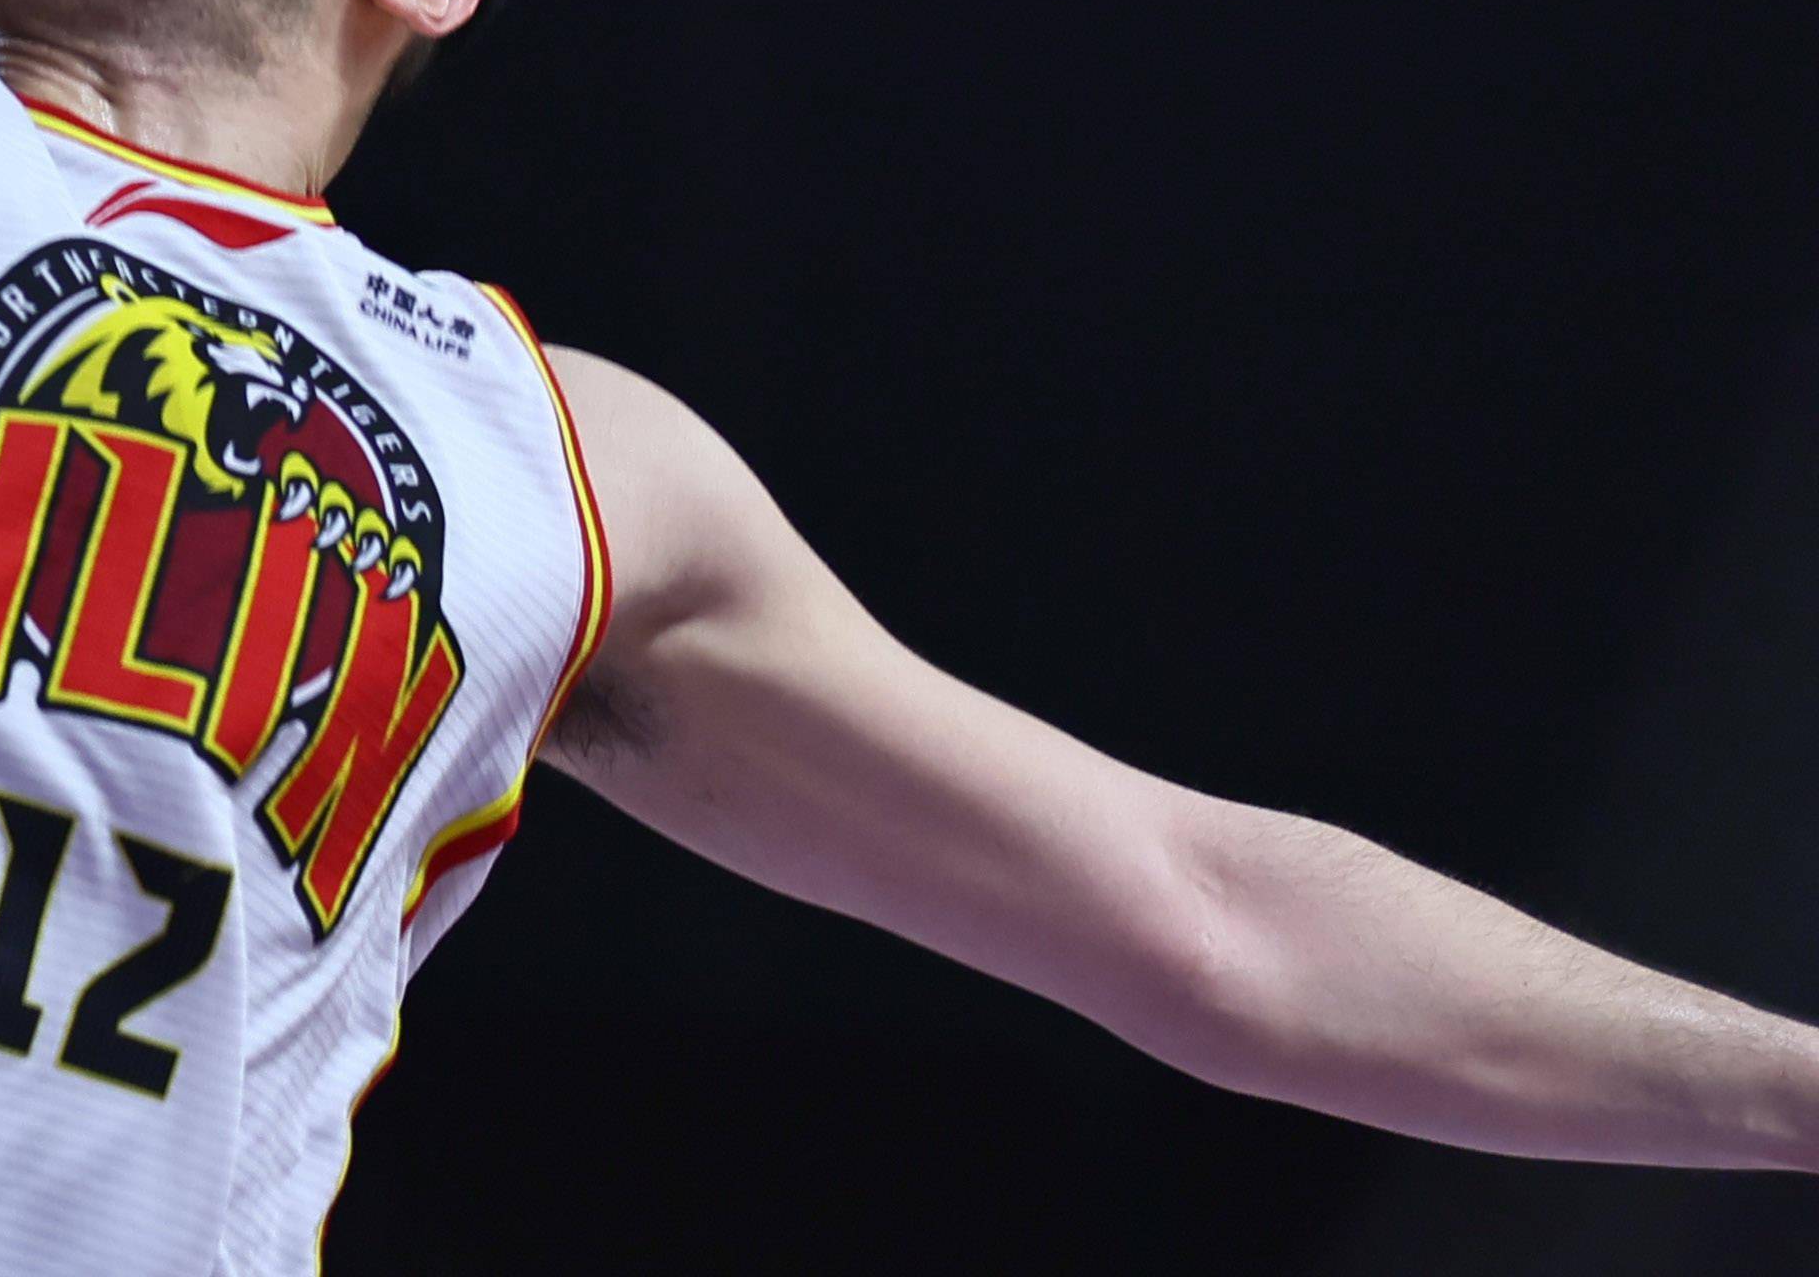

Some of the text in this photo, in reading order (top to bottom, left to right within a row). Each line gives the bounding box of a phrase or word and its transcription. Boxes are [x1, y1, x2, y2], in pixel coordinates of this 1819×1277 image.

[360, 298, 470, 359] CHINA LIFE
[310, 355, 432, 523] TIGERS
